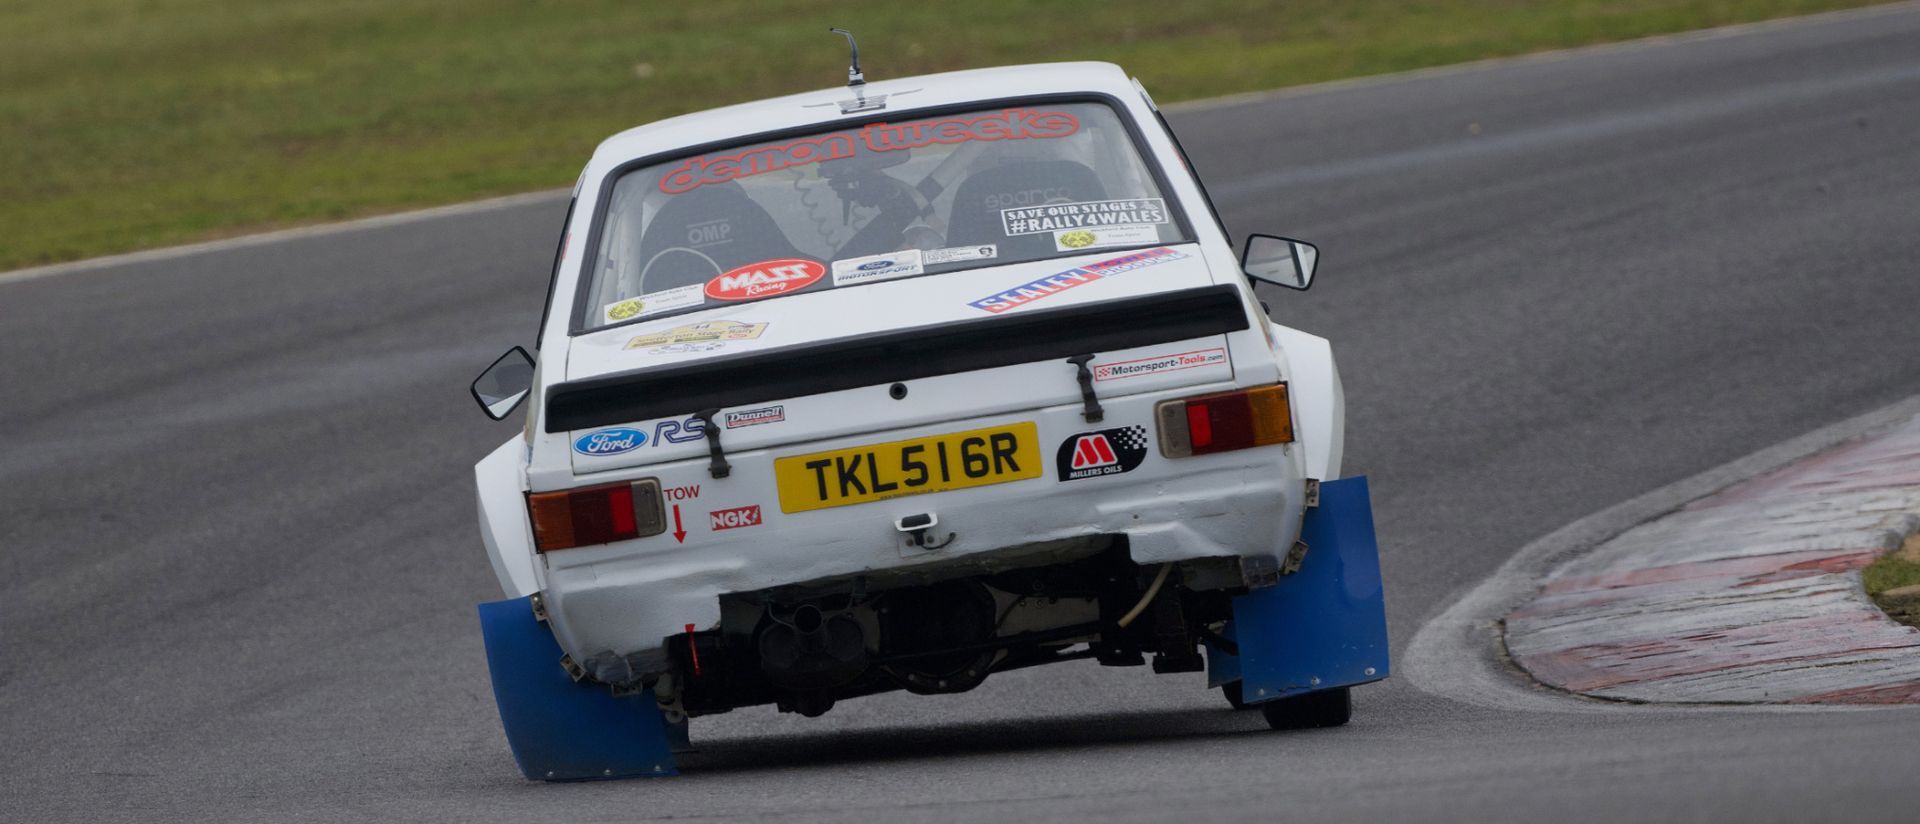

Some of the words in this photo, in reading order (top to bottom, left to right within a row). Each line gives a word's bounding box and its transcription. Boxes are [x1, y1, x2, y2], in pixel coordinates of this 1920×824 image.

[658, 134, 855, 194] demon
[860, 108, 1080, 153] tweeks
[1007, 208, 1046, 221] SAVE
[1048, 204, 1079, 217] OUR
[1082, 201, 1137, 213] STAGES
[1010, 210, 1163, 234] #RALLY4WALES
[688, 223, 731, 245] OMP
[838, 264, 918, 282] MOTORSPORT
[862, 261, 889, 271] Ford
[745, 281, 788, 297] Racing
[978, 271, 1090, 310] SEALEY
[1111, 354, 1223, 376] Motorsport-Tools.com
[728, 408, 782, 422] Dunnell
[587, 432, 634, 453] Ford
[652, 418, 706, 448] RS
[805, 432, 1021, 501] TKL516R
[1069, 467, 1103, 479] MILLERS
[1103, 465, 1123, 474] OILS
[663, 485, 700, 502] TOW
[711, 509, 752, 529] NGK
